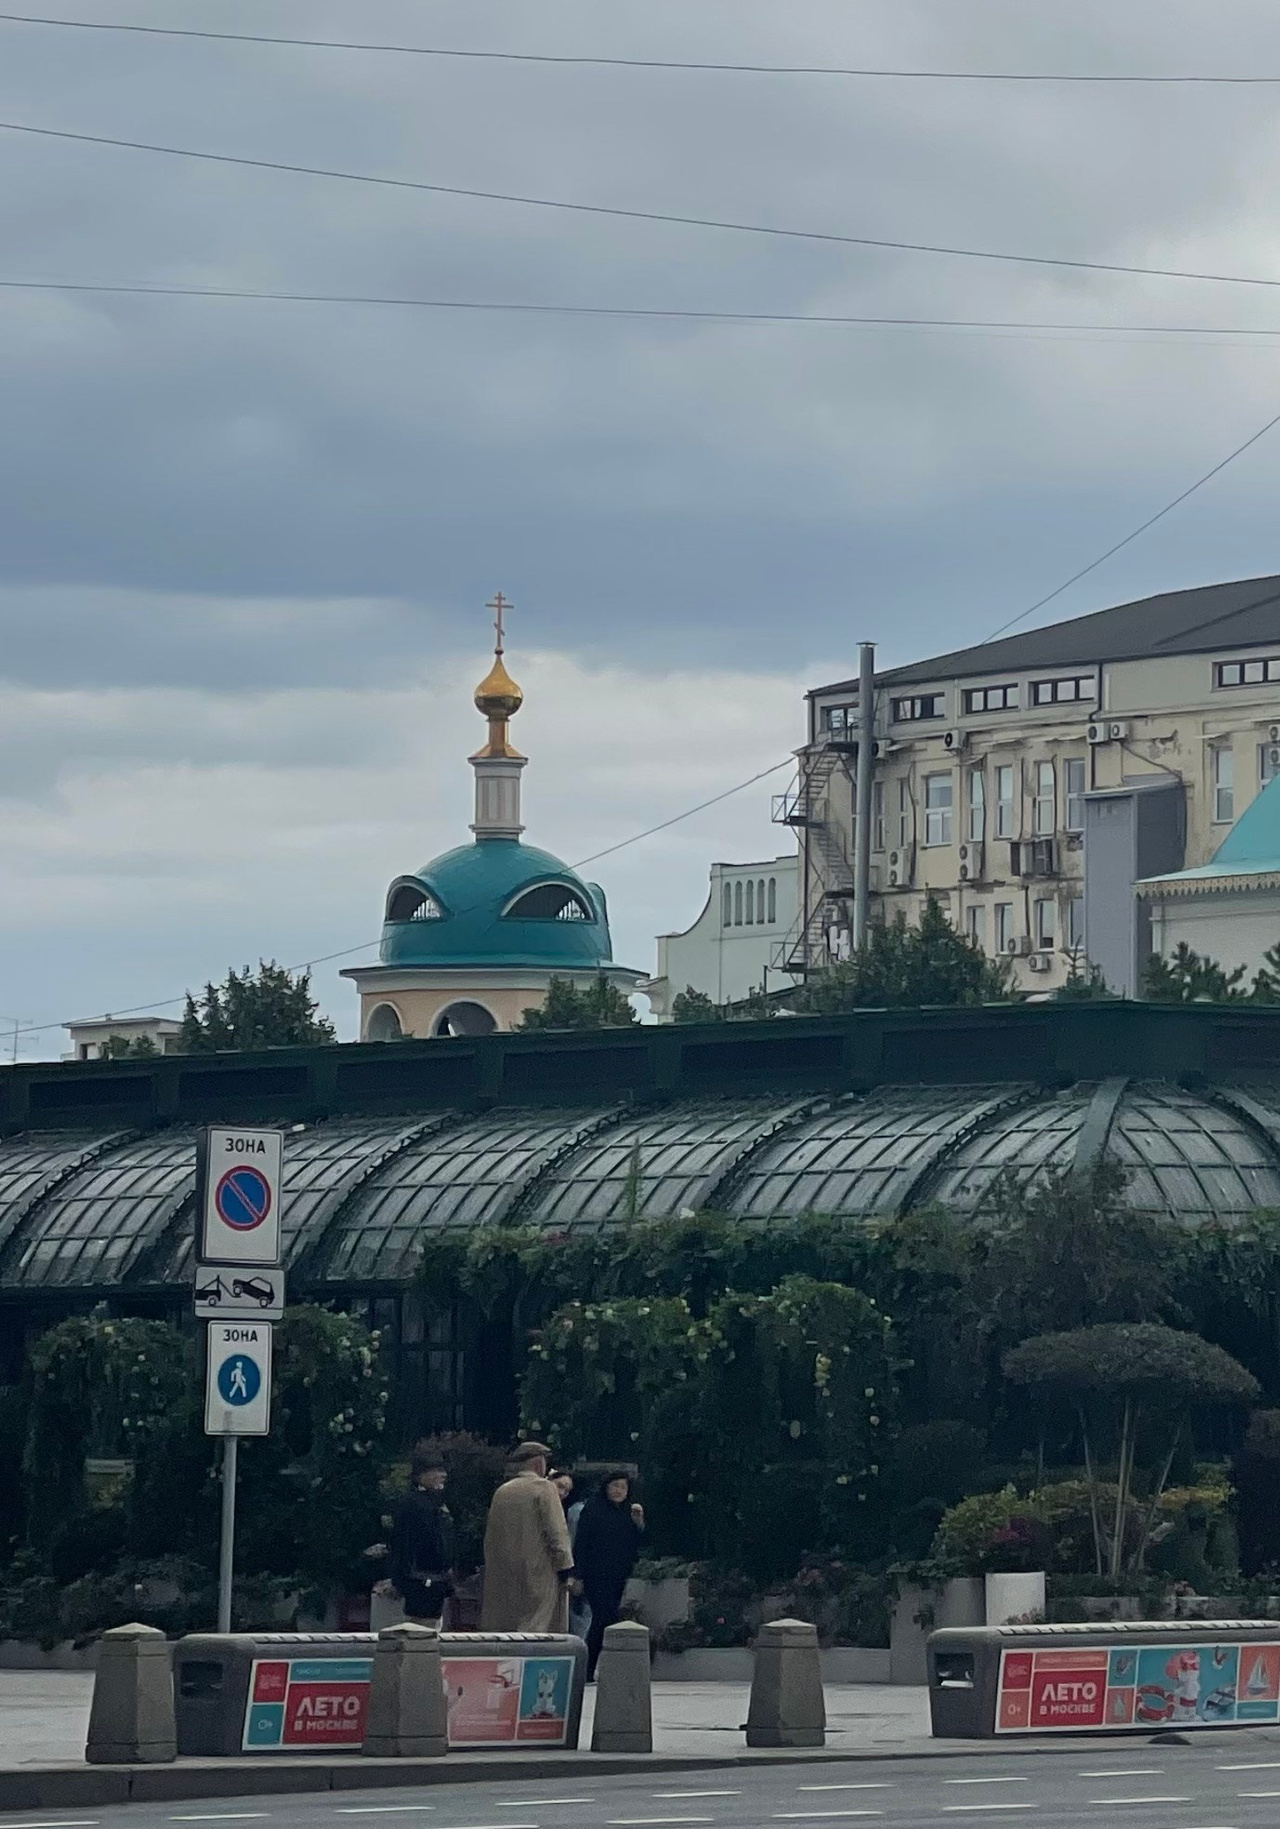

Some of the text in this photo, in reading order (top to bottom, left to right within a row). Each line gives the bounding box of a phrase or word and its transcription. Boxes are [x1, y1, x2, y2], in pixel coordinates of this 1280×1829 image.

[225, 1137, 266, 1154] ЗОНА
[222, 1328, 258, 1342] ЗОНА
[1041, 1682, 1097, 1702] ЛЕТО
[296, 1696, 361, 1717] ЛЕТО
[1039, 1703, 1096, 1715] В МОСКВЕ
[305, 1719, 358, 1731] МОСКВЕ
